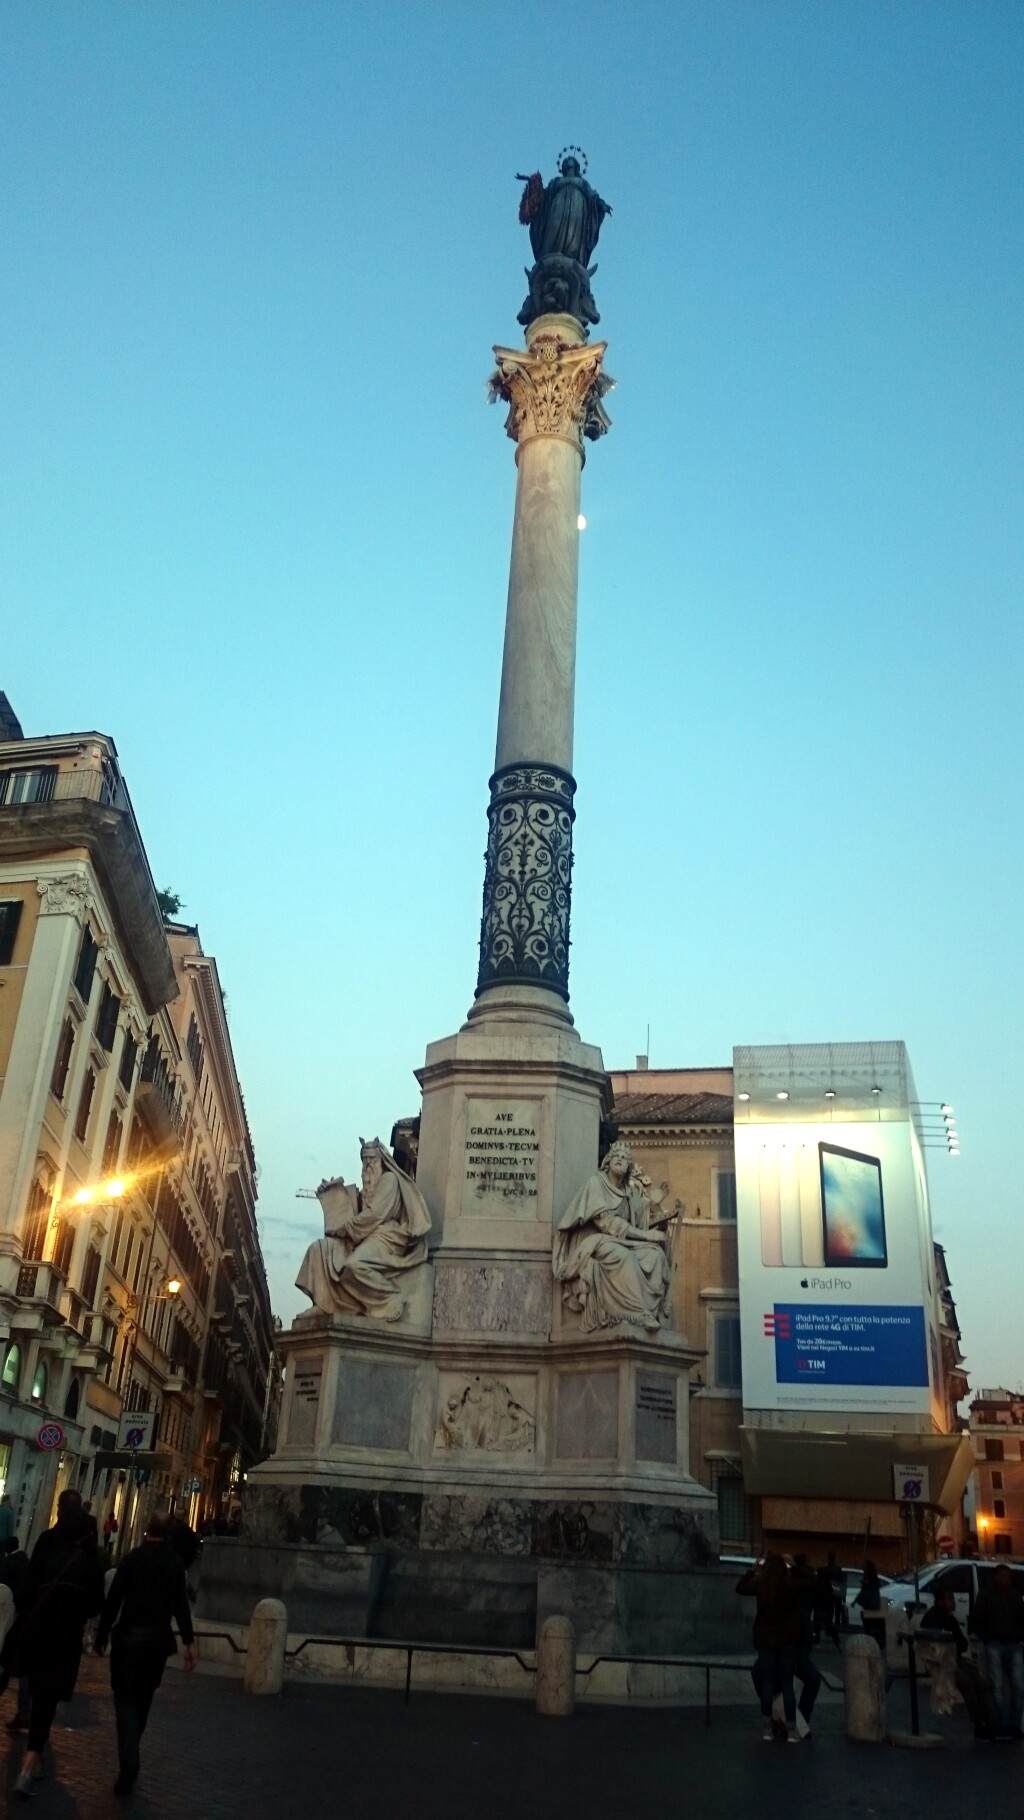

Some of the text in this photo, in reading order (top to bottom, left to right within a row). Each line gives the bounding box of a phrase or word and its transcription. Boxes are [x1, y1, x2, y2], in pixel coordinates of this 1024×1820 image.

[495, 1113, 513, 1121] AVE
[507, 1128, 536, 1136] PLENA
[811, 1278, 851, 1290] iPad Pro
[795, 1313, 811, 1322] iPad
[812, 1314, 824, 1322] Pro
[795, 1322, 813, 1330] della
[814, 1323, 829, 1331] rete
[830, 1323, 841, 1331] 4G
[842, 1323, 849, 1331] di
[808, 1360, 826, 1369] TIM
